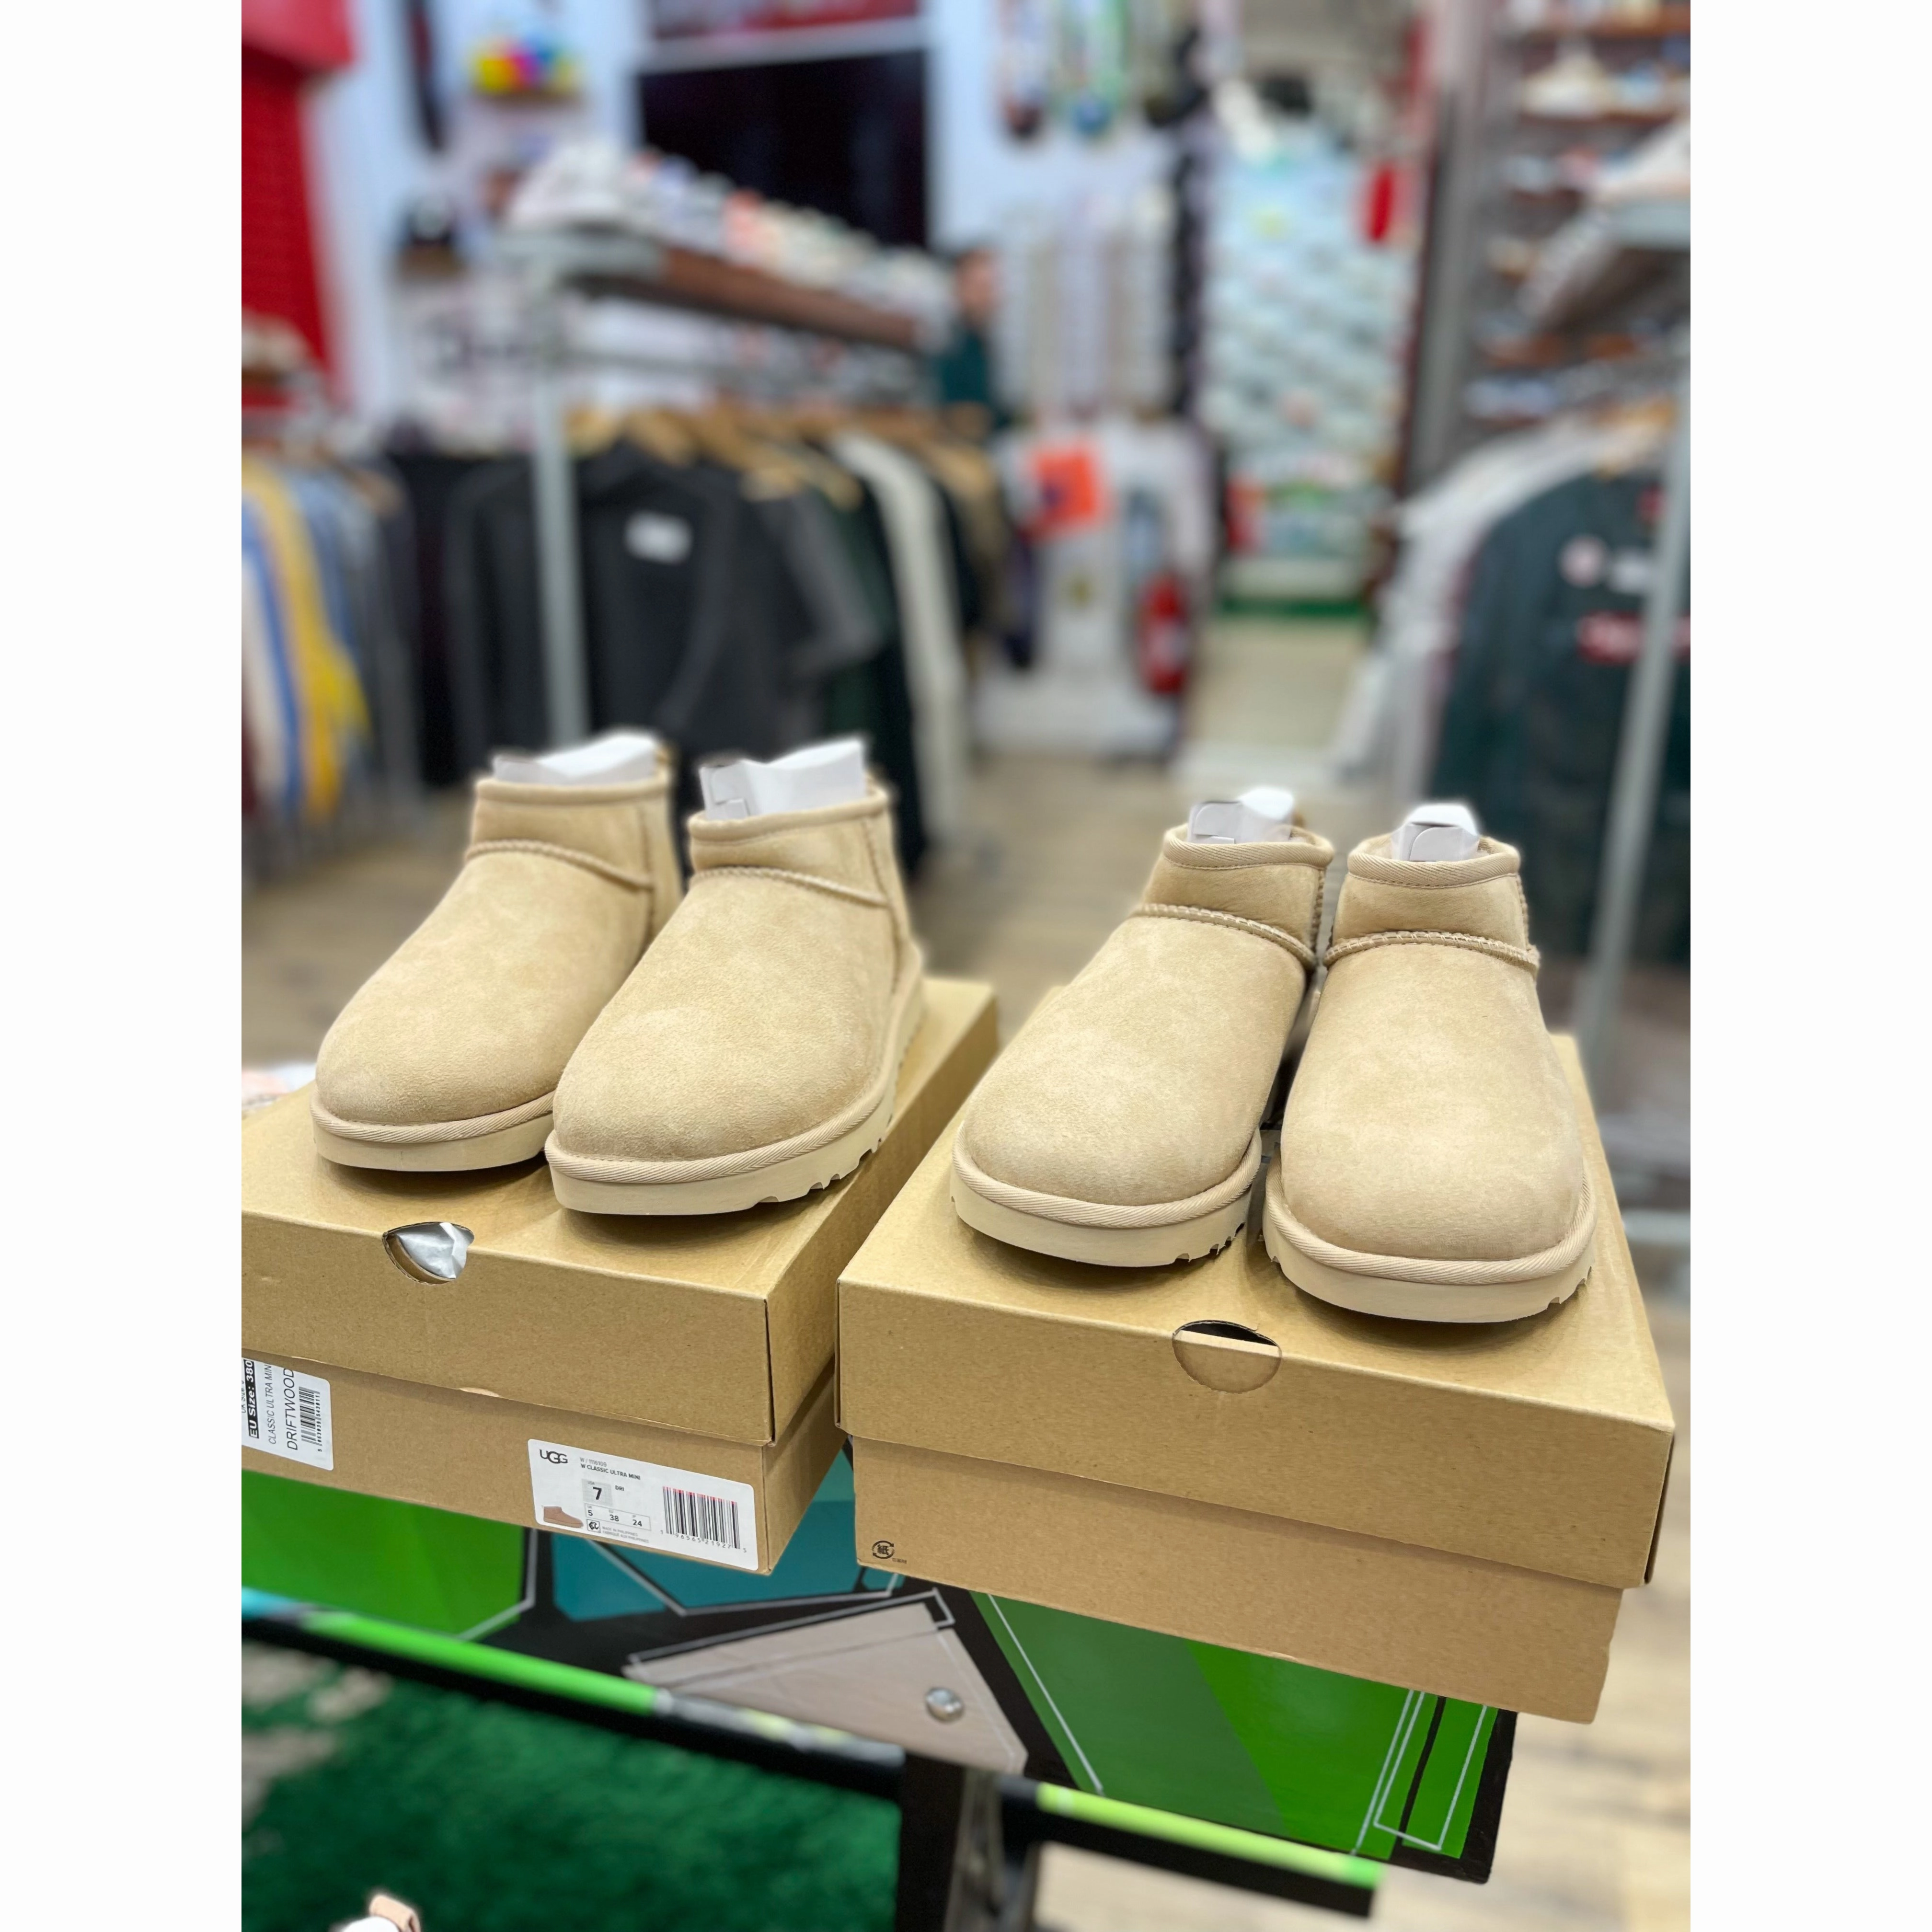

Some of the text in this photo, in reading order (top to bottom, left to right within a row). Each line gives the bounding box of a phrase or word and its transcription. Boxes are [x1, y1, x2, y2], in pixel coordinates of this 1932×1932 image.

[245, 1360, 258, 1438] EU Size: 380
[264, 1383, 275, 1409] ULTRA
[283, 1368, 298, 1450] DRIFTWOOD
[266, 1410, 276, 1445] CLASSIC
[539, 1449, 568, 1464] UGG
[589, 1459, 607, 1467] 1116109
[586, 1465, 609, 1473] CLASSIC
[593, 1486, 602, 1500] 7
[675, 1533, 701, 1543] 96565
[705, 1540, 731, 1549] 21927
